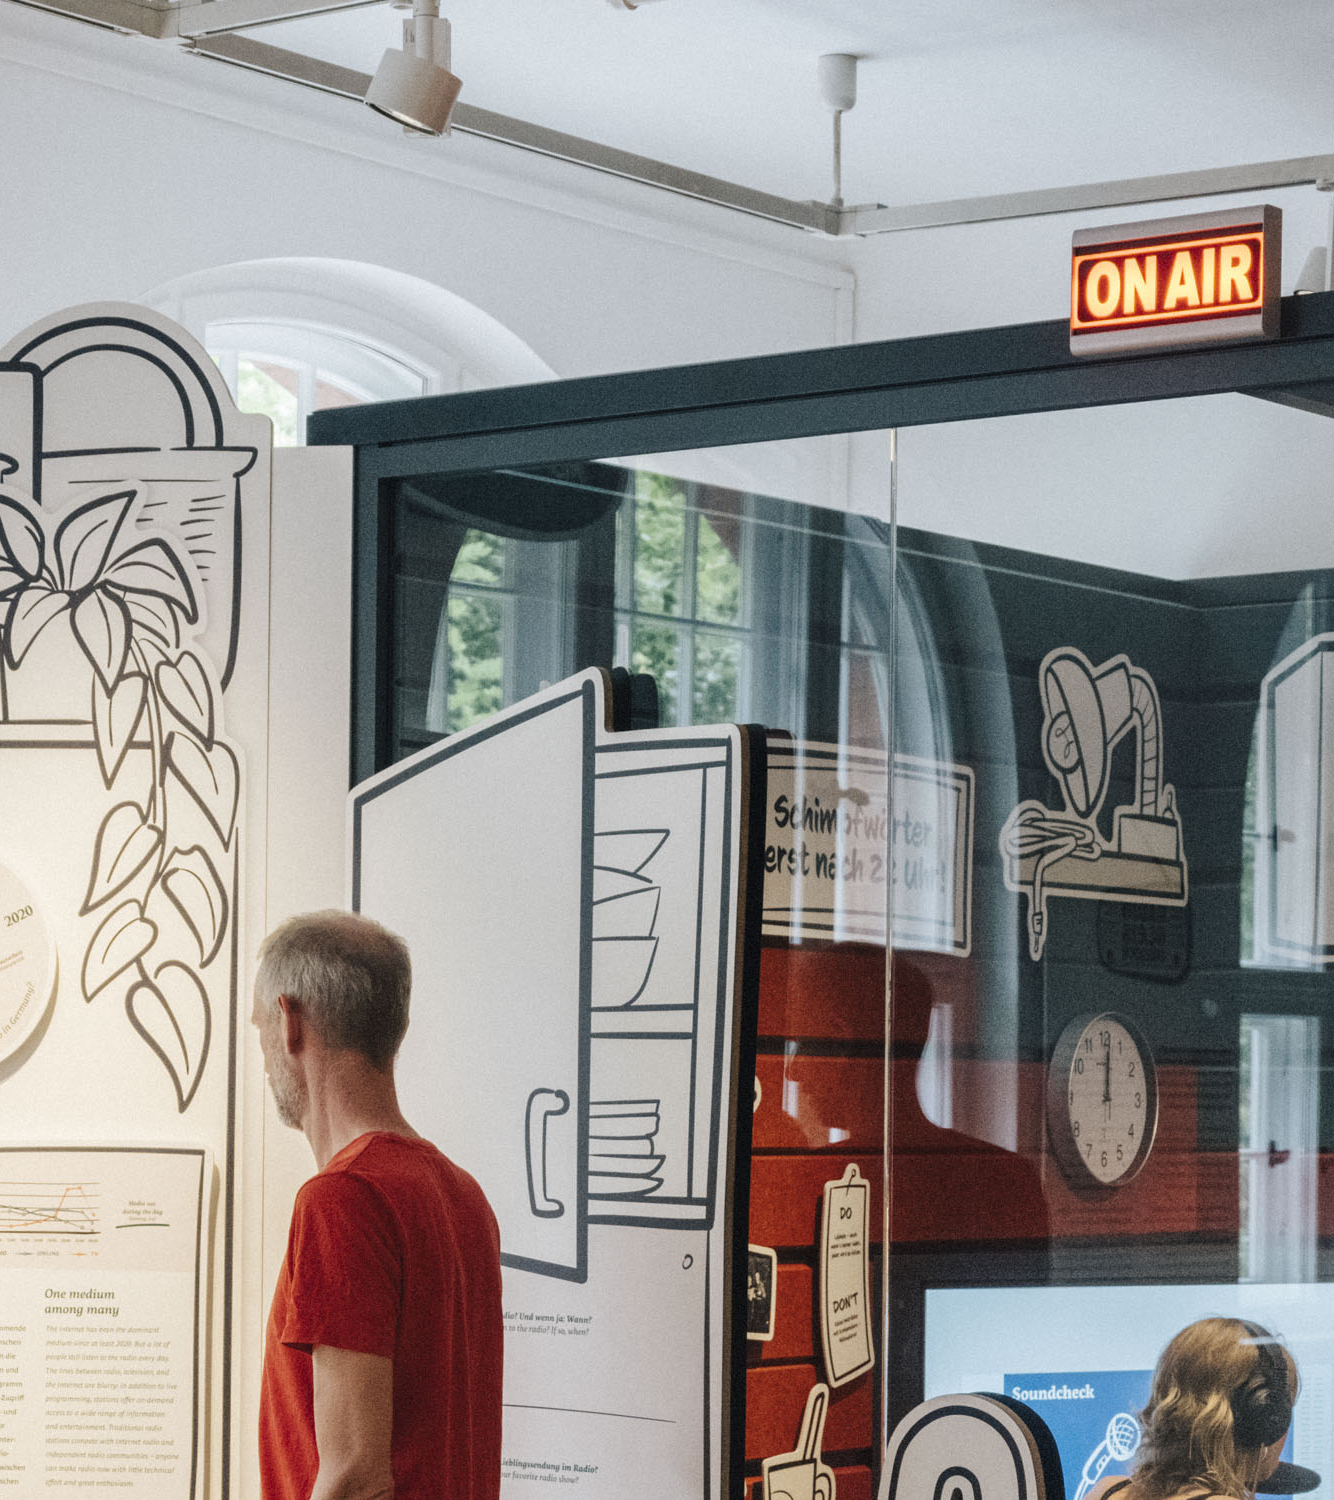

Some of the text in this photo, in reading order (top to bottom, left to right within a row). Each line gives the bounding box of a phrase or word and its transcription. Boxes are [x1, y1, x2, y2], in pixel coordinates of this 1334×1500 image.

[1085, 244, 1254, 319] ON AIR
[764, 842, 810, 876] erst
[3, 904, 34, 928] 2020
[3, 1024, 11, 1035] in
[10, 981, 36, 1026] Germany?
[1085, 1039, 1093, 1054] 11
[1098, 1030, 1111, 1048] 12
[1117, 1041, 1122, 1054] 1
[1074, 1058, 1084, 1075] 10
[1128, 1062, 1135, 1078] 2
[1134, 1092, 1141, 1109] 3
[1073, 1121, 1080, 1138] 8
[1127, 1123, 1135, 1139] 4
[1085, 1143, 1093, 1159] 7
[1117, 1144, 1123, 1160] 5
[1101, 1152, 1107, 1168] 6
[840, 1206, 853, 1220] DO
[44, 1287, 115, 1300] One medium
[44, 1305, 120, 1317] among many
[833, 1292, 859, 1314] DON'T
[519, 1312, 534, 1321] Und
[535, 1314, 555, 1322] wenn
[567, 1315, 593, 1324] Wann?
[517, 1324, 527, 1332] the
[1012, 1384, 1096, 1401] Soundcheck
[501, 1458, 599, 1474] ieblingssendung im Radio?
[512, 1471, 579, 1484] favorite radio show?
